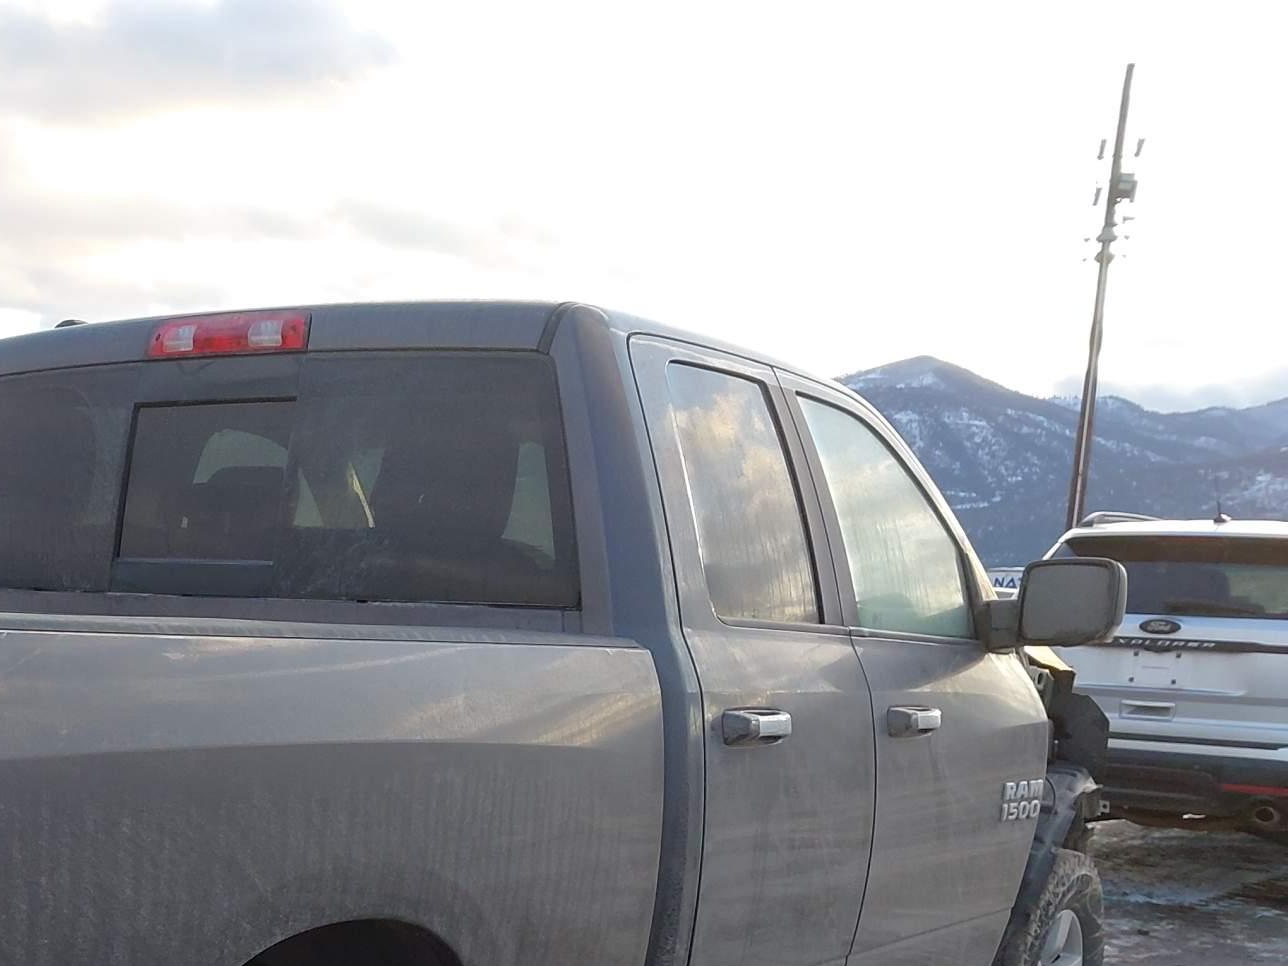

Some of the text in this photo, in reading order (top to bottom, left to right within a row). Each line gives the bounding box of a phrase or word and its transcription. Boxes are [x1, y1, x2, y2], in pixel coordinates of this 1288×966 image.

[994, 577, 1022, 589] NA
[1117, 638, 1216, 648] XPLORER
[1003, 779, 1044, 800] RAM
[1002, 800, 1041, 820] 1500
